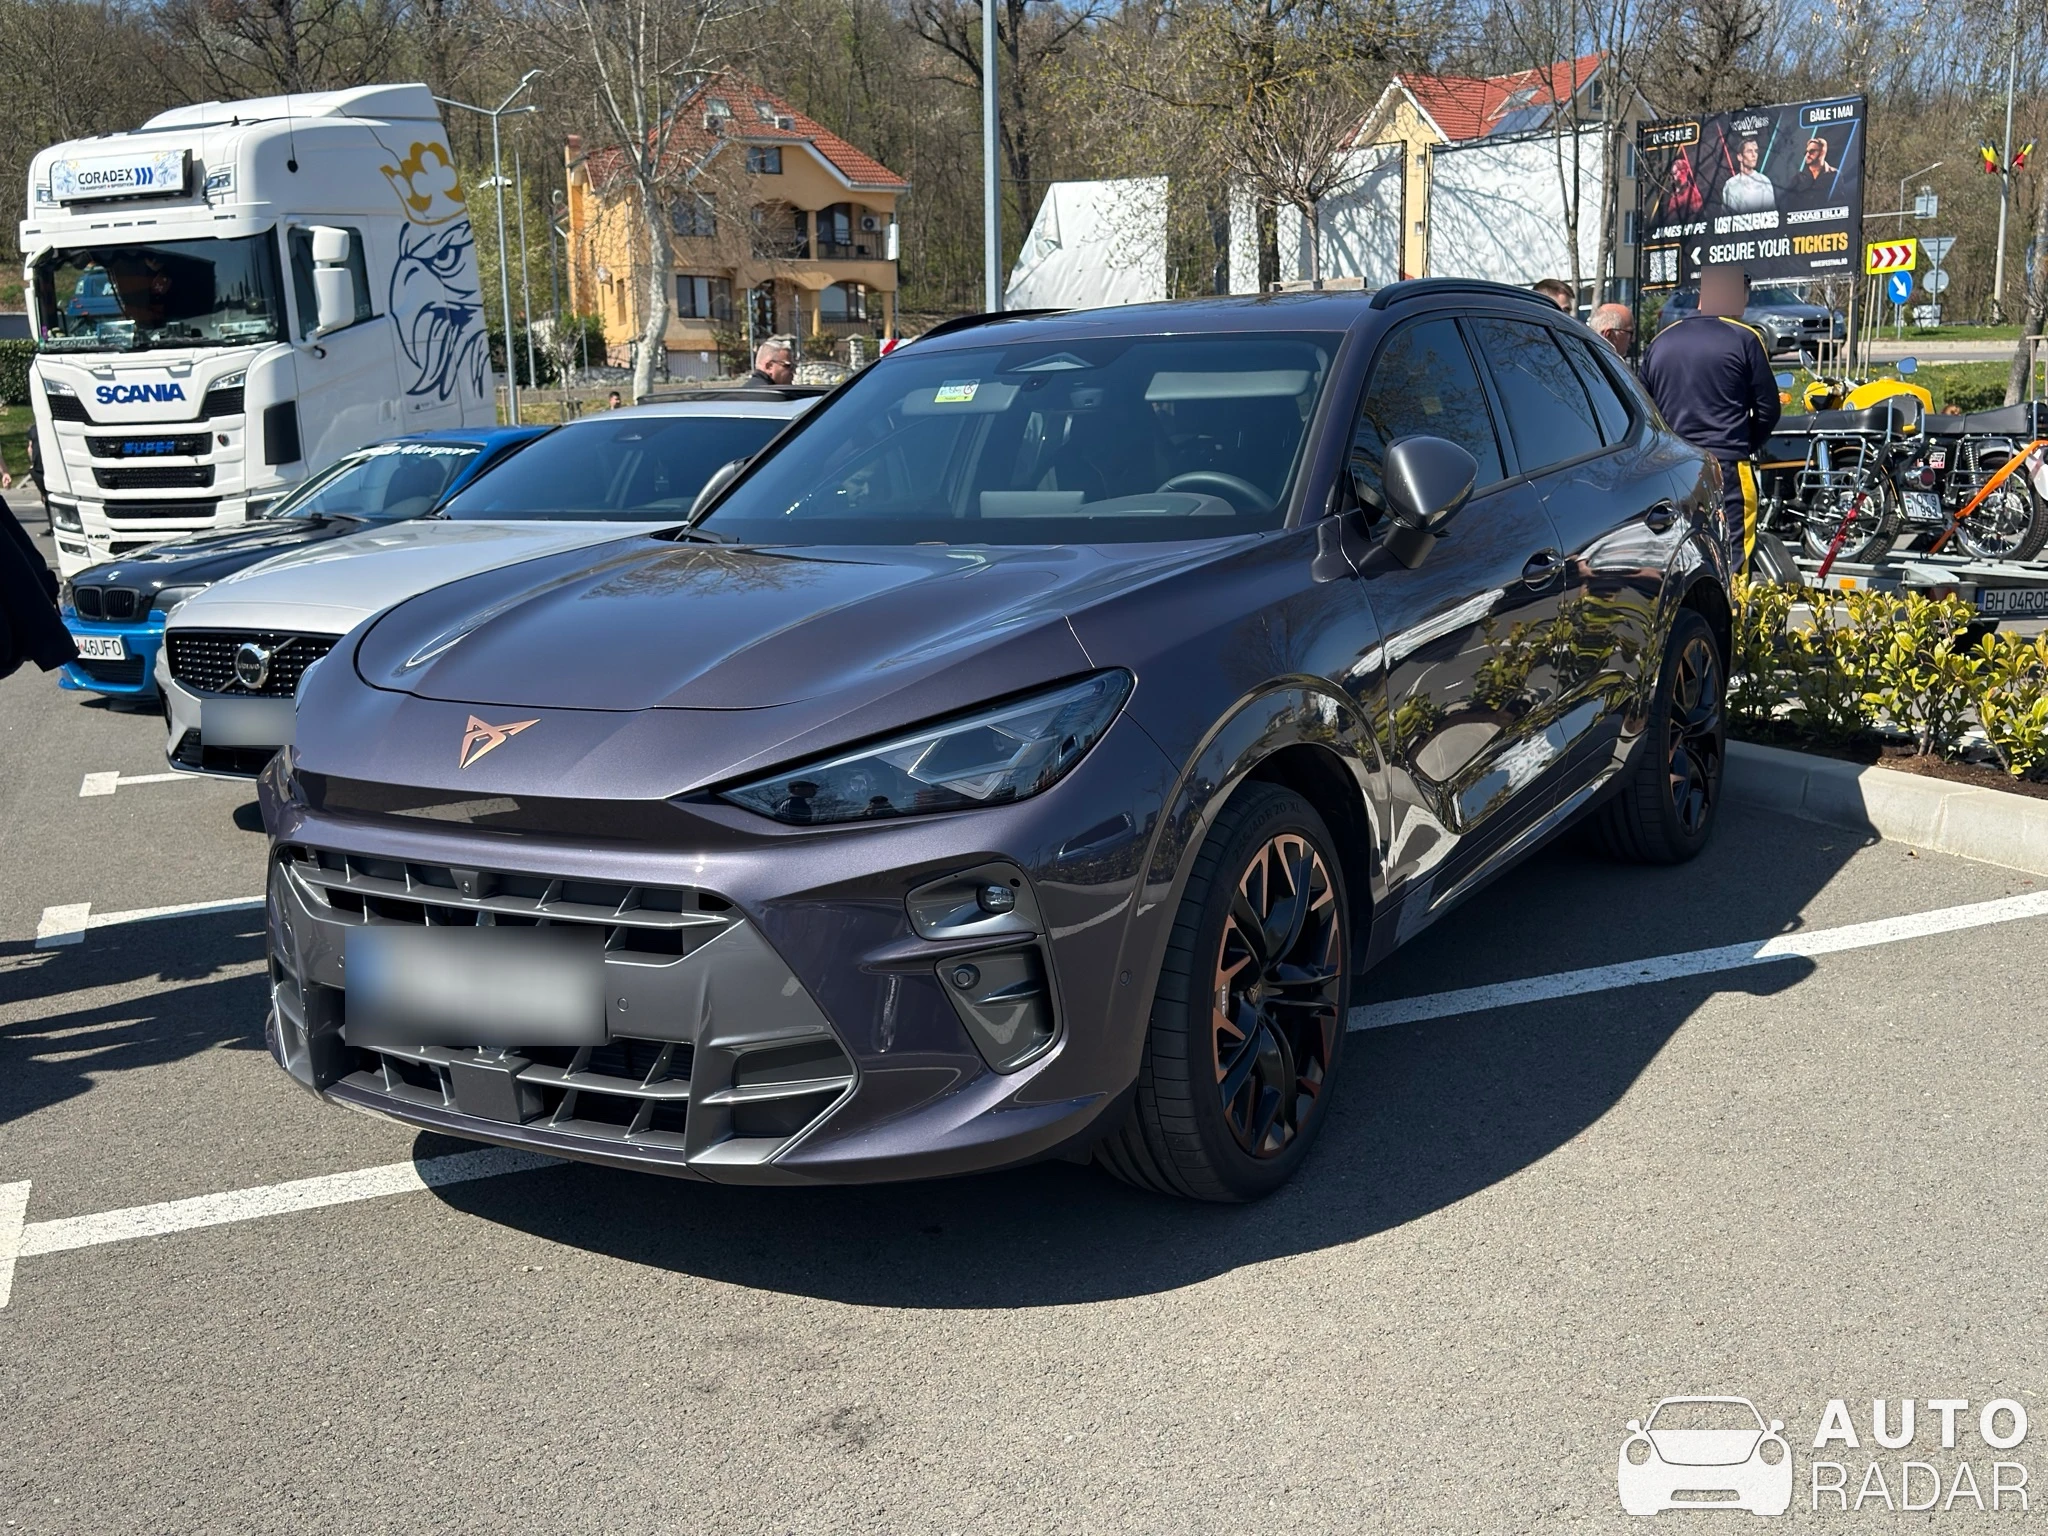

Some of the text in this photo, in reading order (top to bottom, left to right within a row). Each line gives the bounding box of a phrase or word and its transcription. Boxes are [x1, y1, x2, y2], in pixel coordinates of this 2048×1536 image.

[1832, 107, 1837, 119] 1
[1838, 105, 1854, 118] MAI
[78, 168, 133, 185] CORADEX
[1787, 207, 1849, 222] JONAS BLUE
[1652, 225, 1682, 239] JAMES
[1715, 216, 1733, 234] LOST
[1709, 232, 1849, 263] SECURE YOUR TICKETS
[96, 383, 187, 405] SCANIA
[1985, 592, 2006, 610] BH
